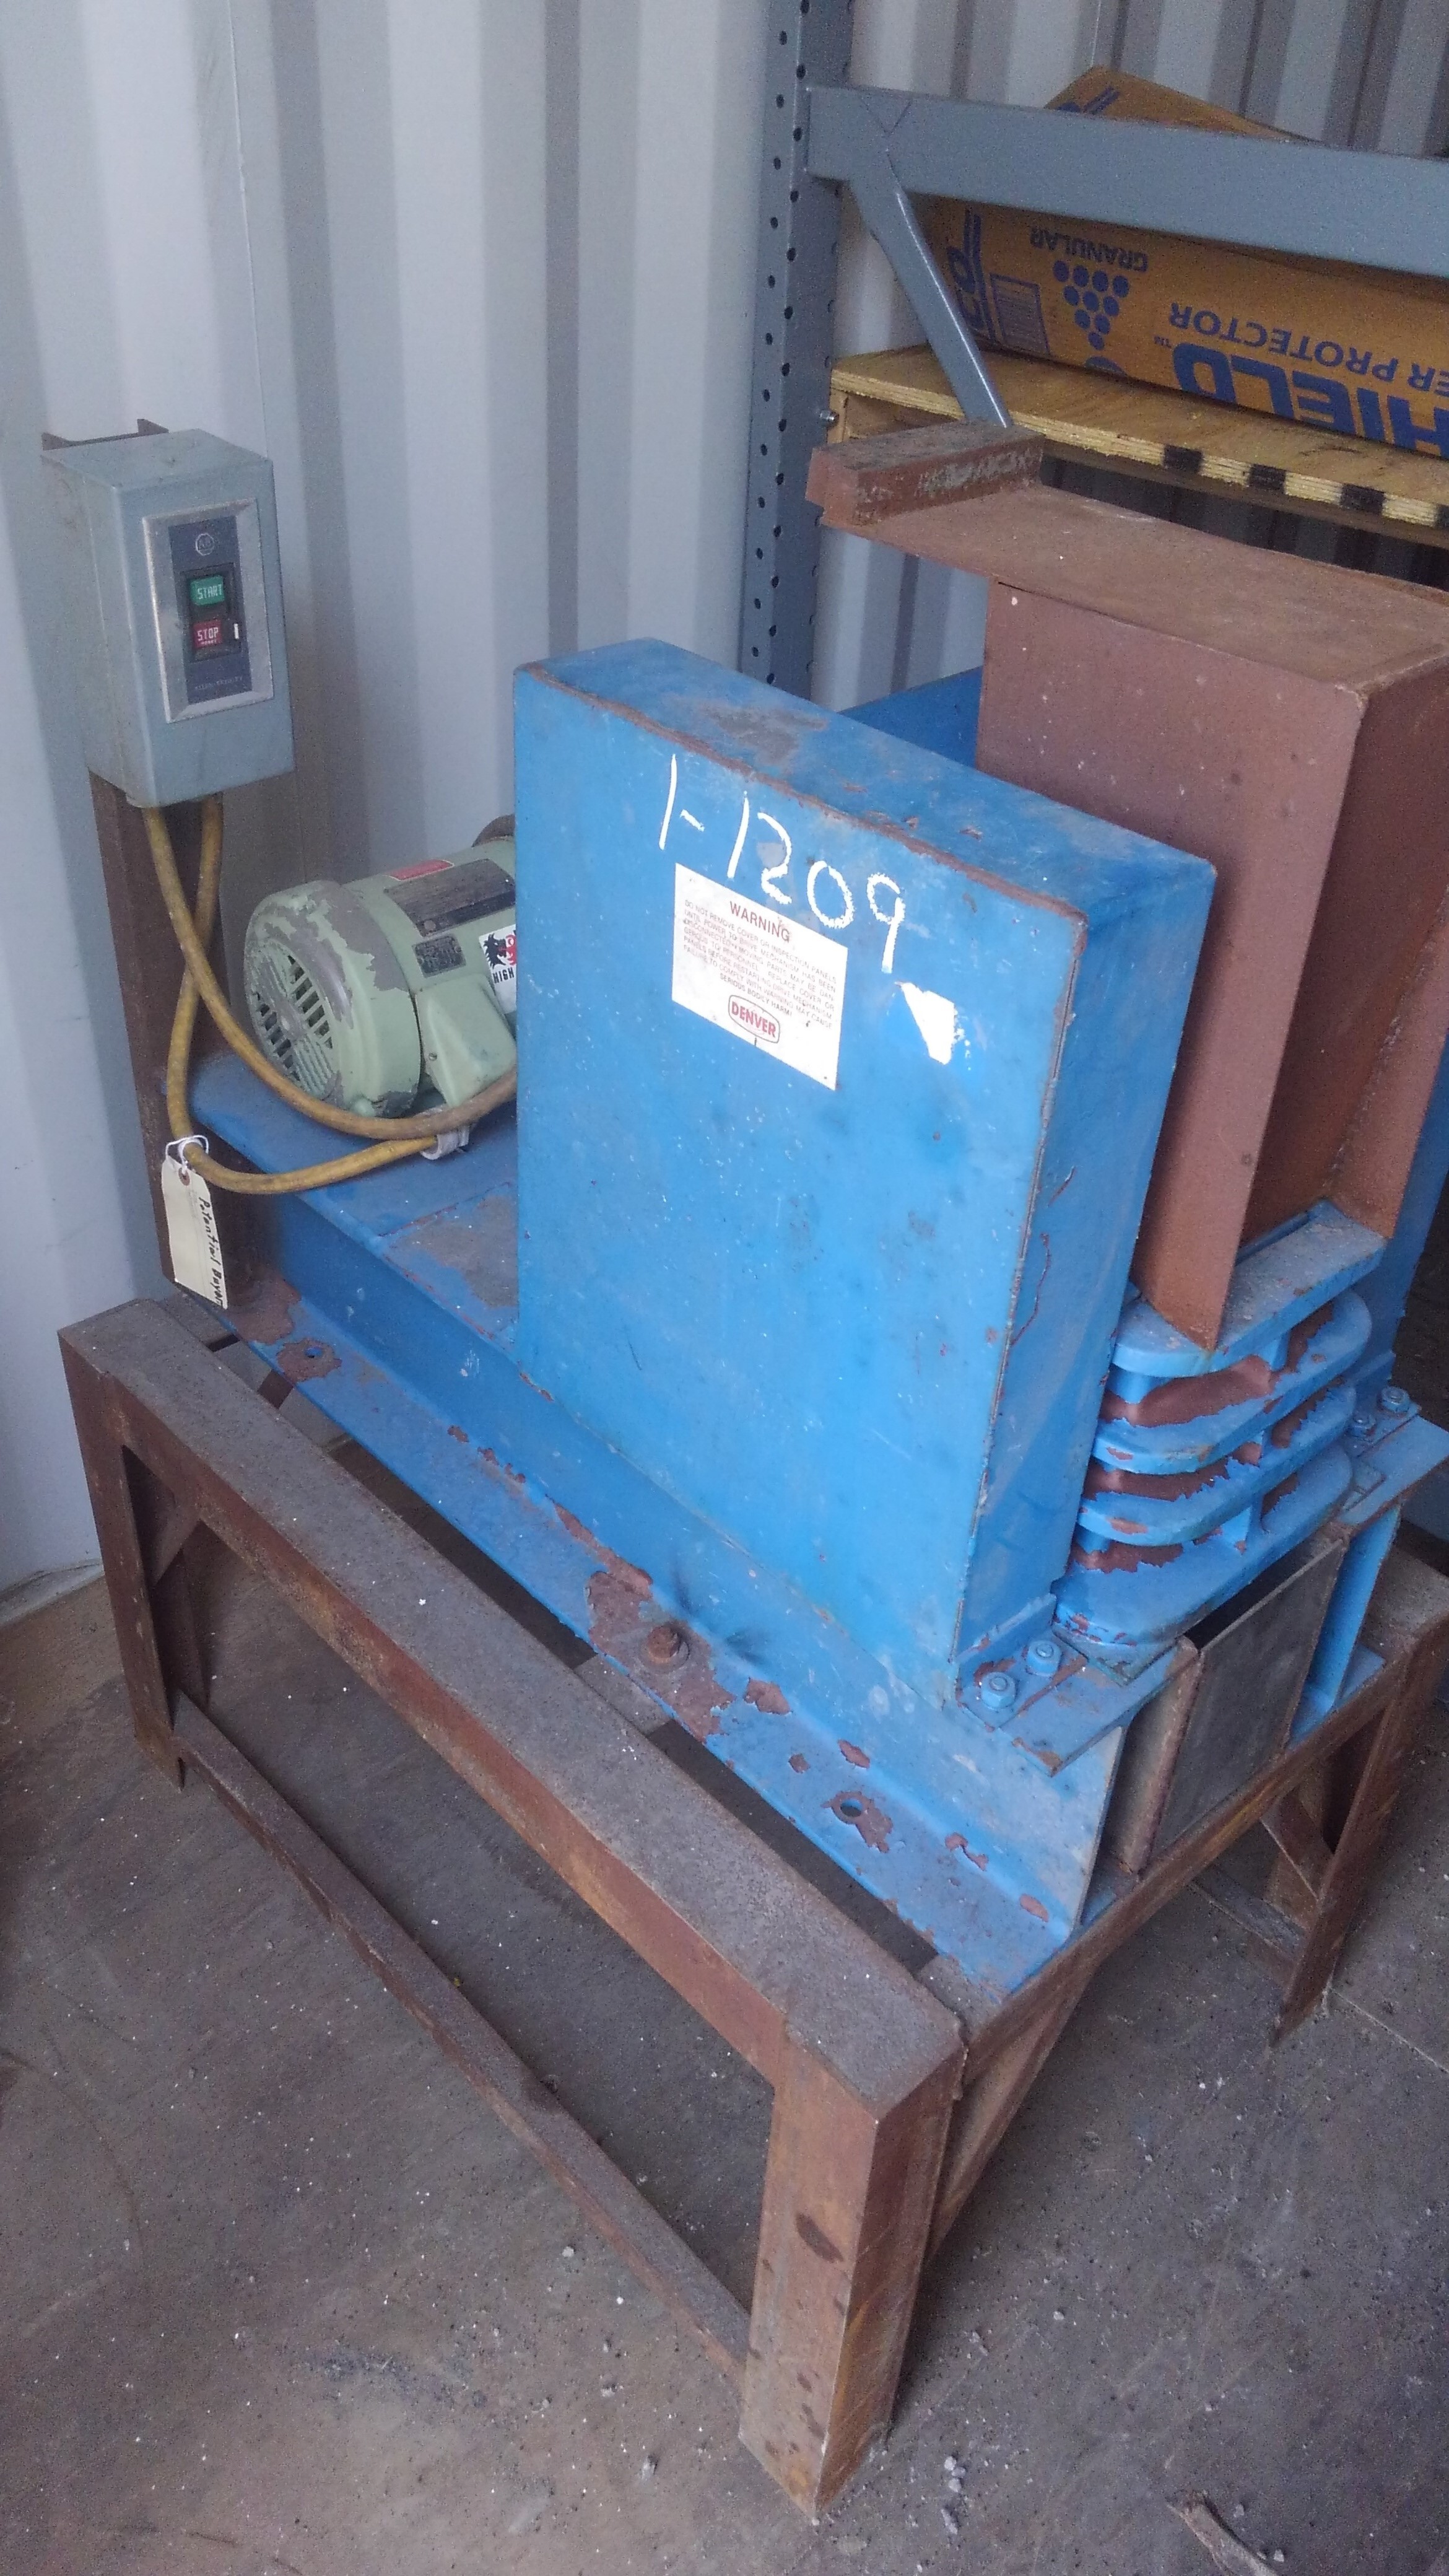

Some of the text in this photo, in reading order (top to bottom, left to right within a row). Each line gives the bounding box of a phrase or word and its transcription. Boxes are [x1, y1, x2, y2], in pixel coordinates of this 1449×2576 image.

[1030, 227, 1149, 273] GRANULAR
[1168, 302, 1399, 383] PROTECTOR
[197, 584, 222, 600] START
[197, 627, 219, 641] STOP
[659, 753, 906, 974] 1-1209
[729, 901, 790, 943] WARNING
[684, 908, 701, 924] UNTIL
[703, 918, 725, 937] POWER
[728, 931, 737, 943] TO
[802, 969, 816, 983] HAS
[818, 977, 835, 993] BEEN
[684, 935, 707, 954] PANELS
[708, 948, 731, 967] BEFORE
[695, 905, 707, 918] NOT
[710, 912, 734, 932] REMOVE
[737, 926, 758, 944] COVER
[771, 943, 809, 969] INSPECTION
[811, 964, 837, 984] PANELS
[492, 967, 515, 984] HIGH
[710, 958, 717, 969] TO
[719, 963, 743, 983] COMPLY
[796, 1003, 809, 1018] MAY
[811, 1011, 832, 1030] CAUSE
[720, 972, 746, 992] SERIOUS
[747, 987, 768, 1005] BODILY
[767, 960, 786, 977] PARTS
[790, 972, 804, 986] MAY
[807, 981, 816, 992] BE
[768, 970, 796, 991] REPLACE
[799, 986, 821, 1005] COVER
[825, 1000, 834, 1011] OR
[731, 1000, 777, 1038] DENVER
